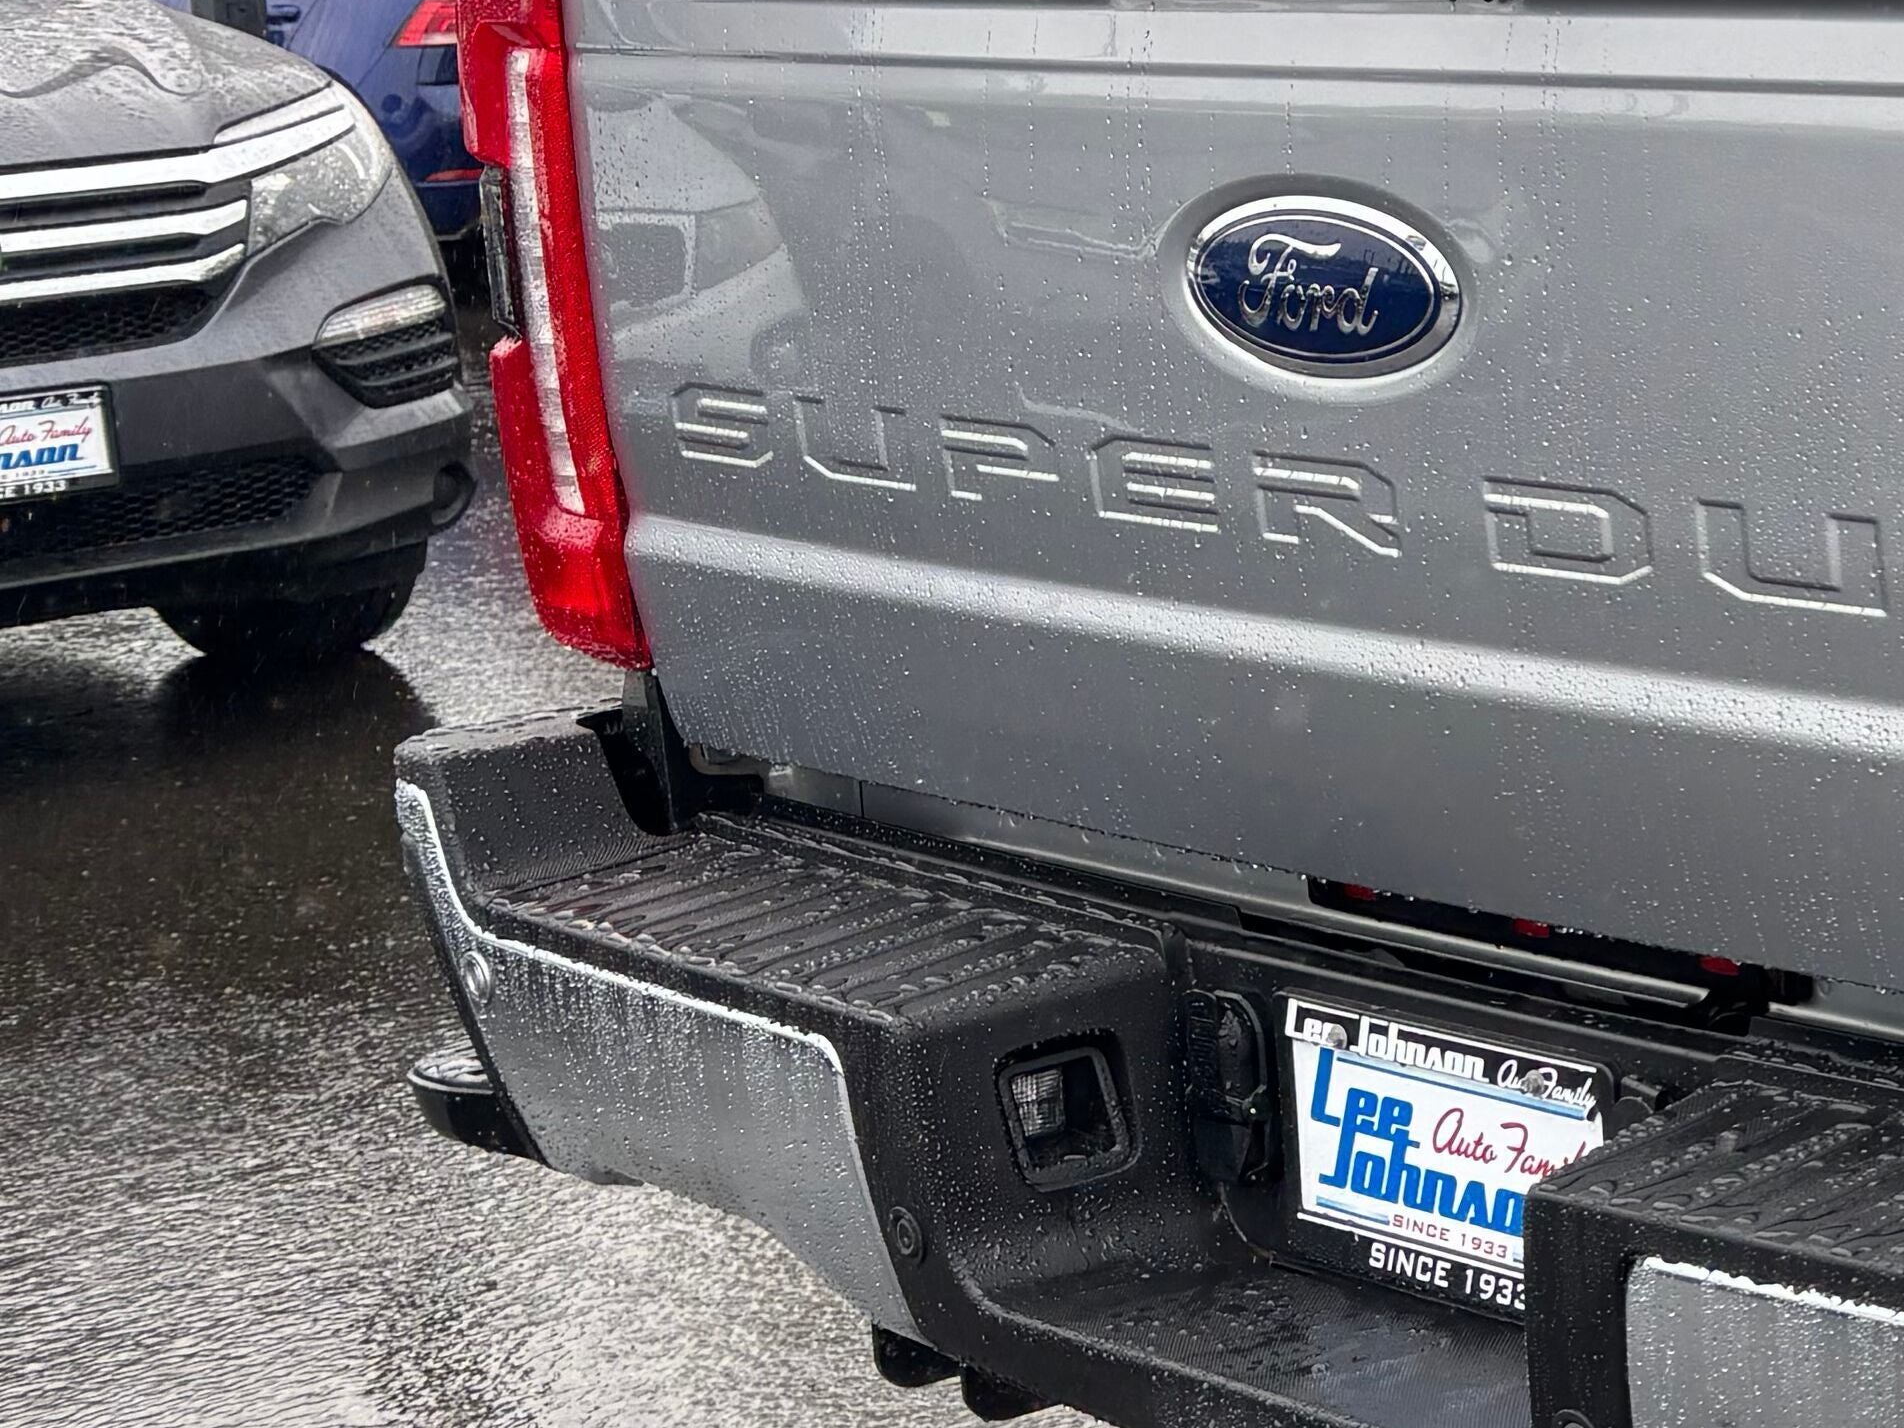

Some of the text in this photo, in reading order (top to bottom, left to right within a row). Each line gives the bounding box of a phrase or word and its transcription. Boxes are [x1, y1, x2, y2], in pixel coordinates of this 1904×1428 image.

[1238, 232, 1379, 337] Ford
[37, 416, 92, 443] Family
[24, 480, 67, 495] 1933
[672, 381, 1400, 558] SUPER
[1349, 1015, 1490, 1084] Johnson
[1310, 1046, 1415, 1137] Lee
[1433, 1108, 1498, 1164] Auto
[1318, 1120, 1525, 1237] Johnso
[1392, 1214, 1508, 1259] SINCE 1933
[1368, 1242, 1525, 1311] SINCE 1933
